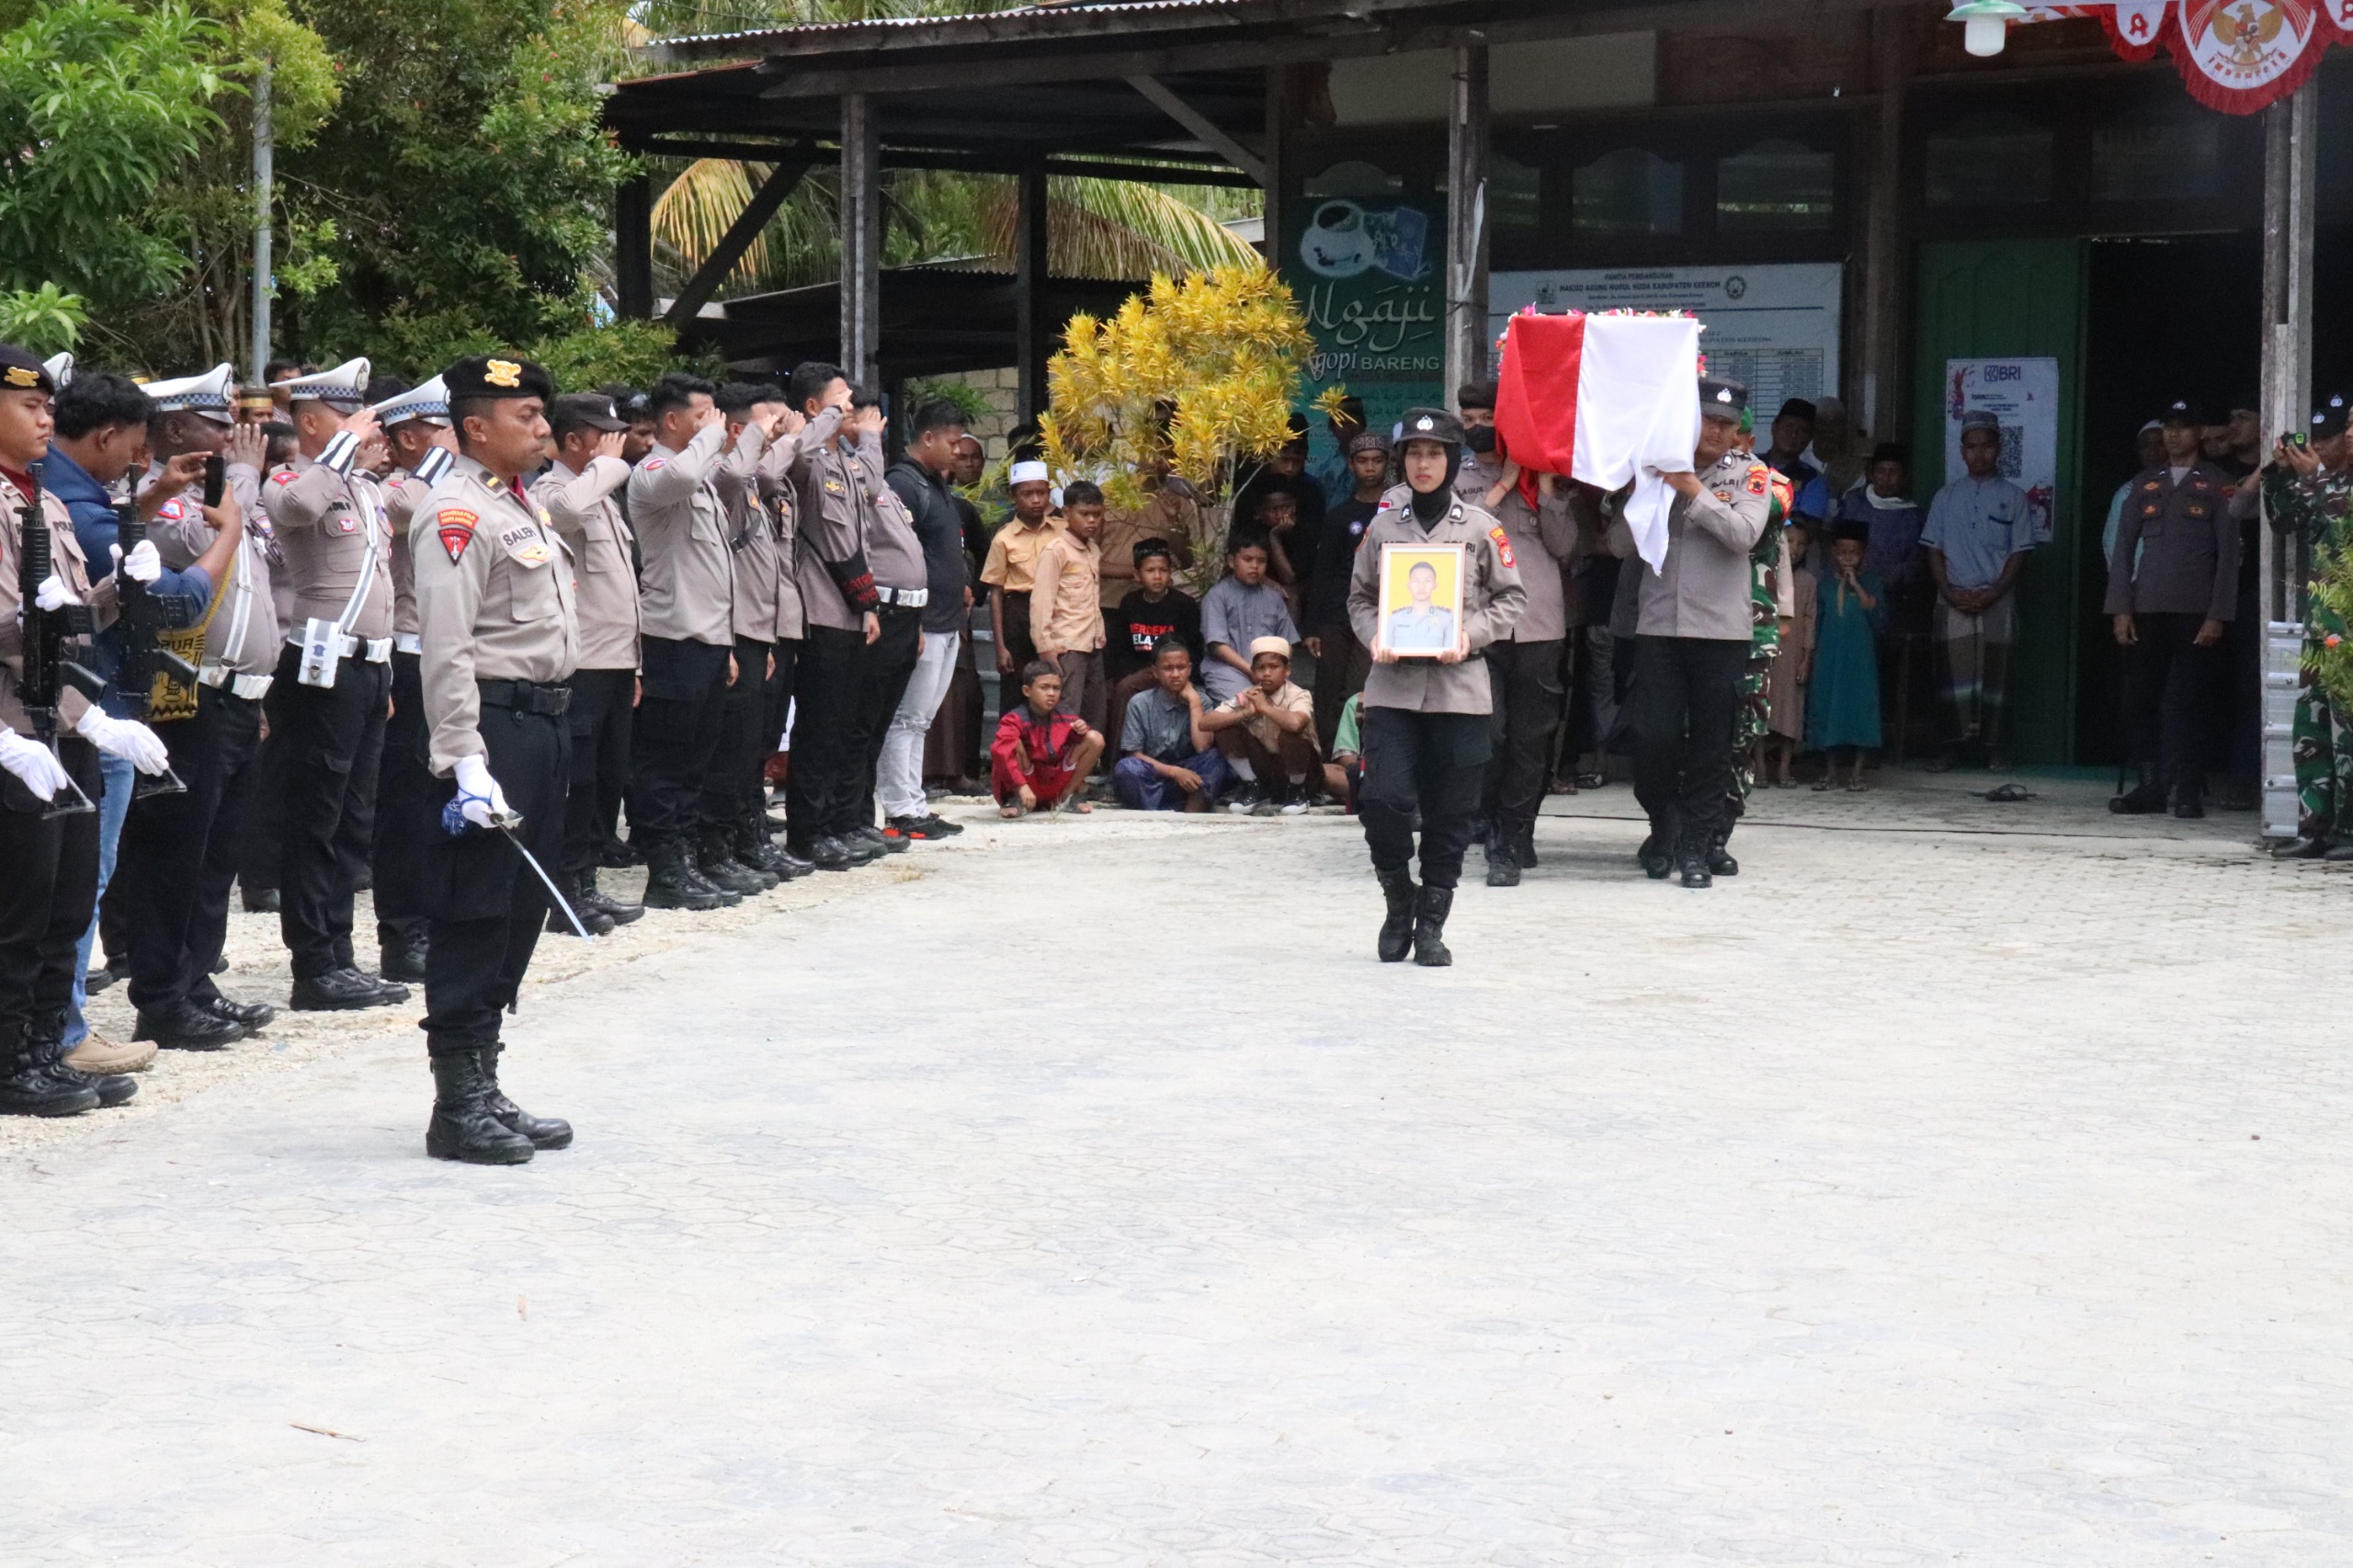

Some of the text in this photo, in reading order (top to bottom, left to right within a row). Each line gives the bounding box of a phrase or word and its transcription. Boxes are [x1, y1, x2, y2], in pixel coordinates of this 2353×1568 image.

[1608, 282, 1631, 290] NURUL
[1653, 281, 1692, 290] KABUPATEN
[1693, 280, 1722, 289] KEEROM
[1306, 280, 1437, 353] Ngaji
[1361, 357, 1440, 370] BARENG
[1999, 366, 2021, 381] BRI
[502, 526, 538, 547] SALEH
